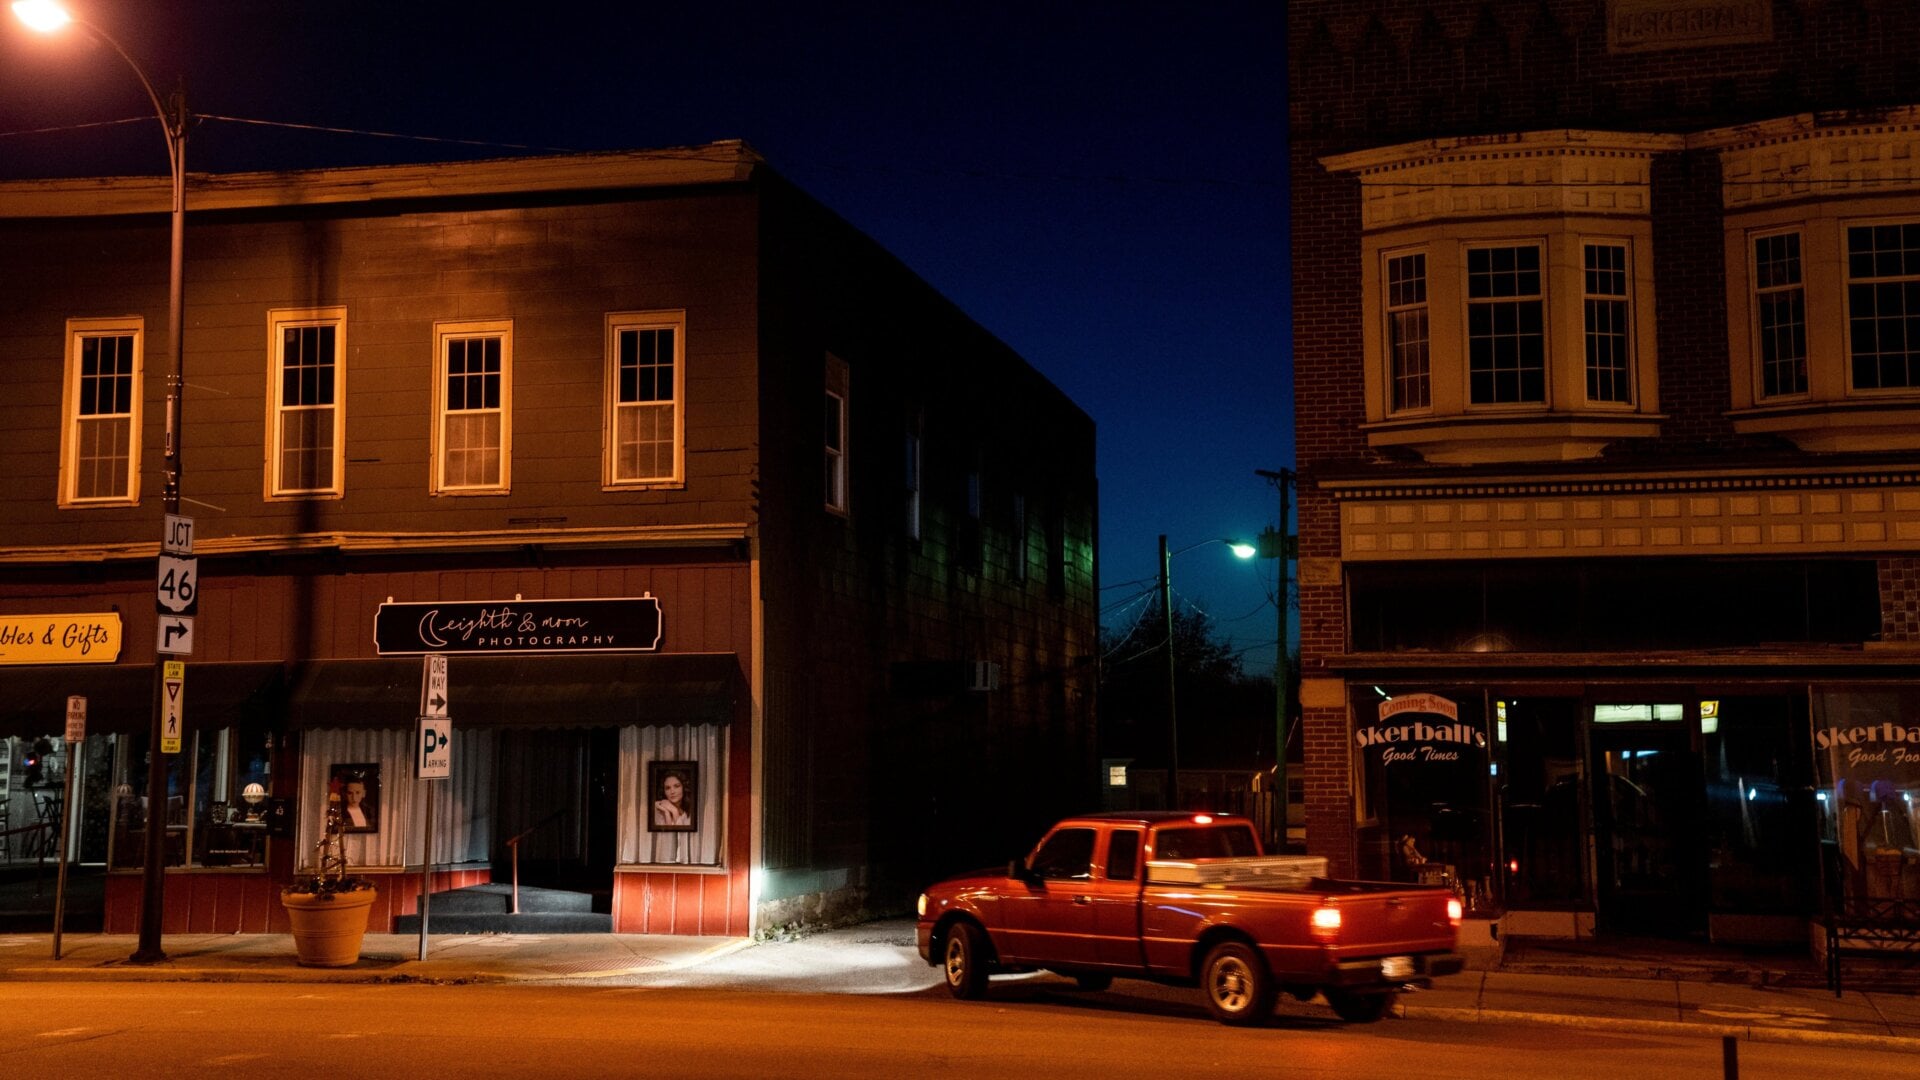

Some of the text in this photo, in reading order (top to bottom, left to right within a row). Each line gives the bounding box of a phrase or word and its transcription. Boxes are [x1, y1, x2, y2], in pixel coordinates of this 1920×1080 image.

[168, 521, 191, 547] JCT
[160, 568, 192, 601] 46
[438, 607, 589, 641] eighth & moon
[42, 623, 56, 645] &
[62, 623, 108, 656] Gifts
[478, 635, 615, 647] PHOTOGRAPHY
[432, 660, 445, 674] ONE
[431, 676, 445, 690] WAY
[1381, 695, 1456, 718] Coming Soon
[1382, 746, 1459, 767] Good Times
[1848, 747, 1887, 768] Good
